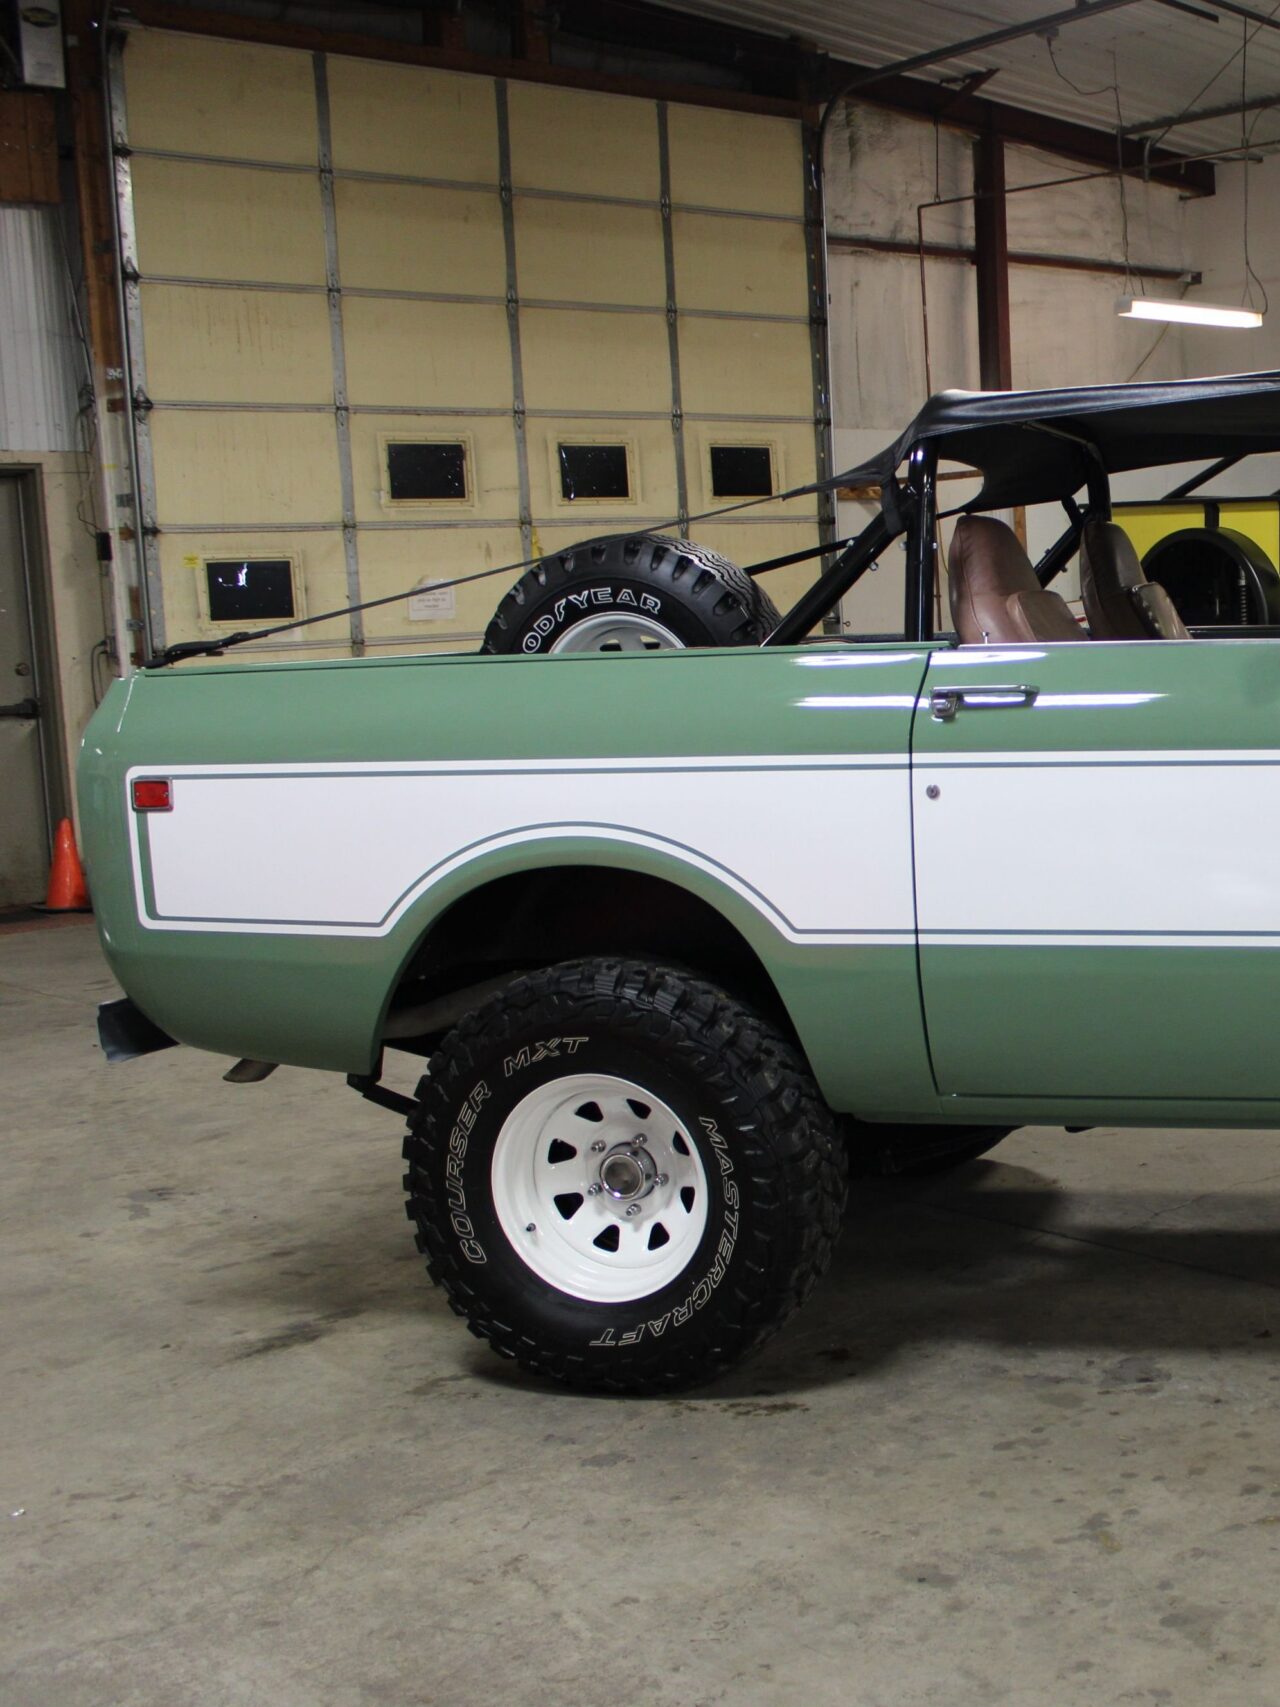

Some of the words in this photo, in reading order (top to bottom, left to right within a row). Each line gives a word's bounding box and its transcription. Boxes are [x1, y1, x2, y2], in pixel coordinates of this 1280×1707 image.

[522, 587, 662, 654] ODYEAR
[445, 1080, 493, 1265] COURSER
[503, 1036, 589, 1078] MXT
[589, 1115, 740, 1347] MASTERCRAFT
